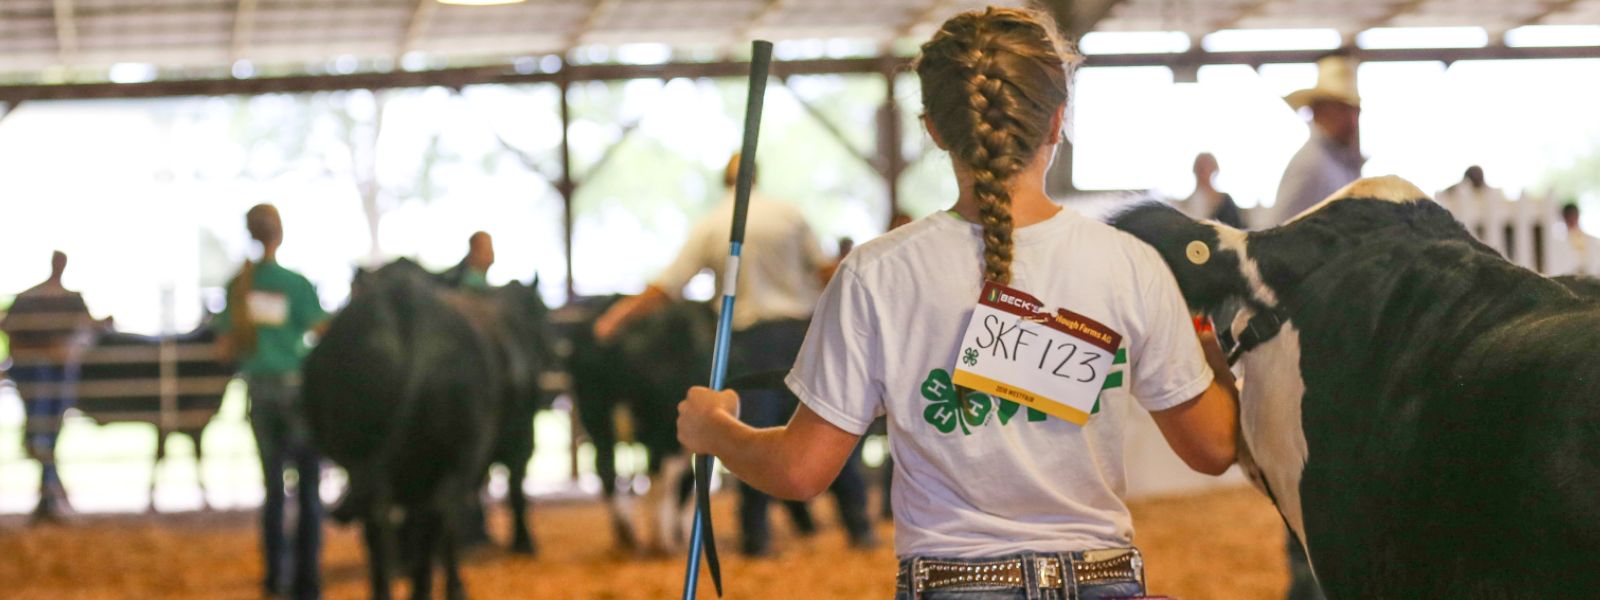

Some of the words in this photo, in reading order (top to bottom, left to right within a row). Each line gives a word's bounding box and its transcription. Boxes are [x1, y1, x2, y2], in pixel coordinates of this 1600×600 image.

[976, 314, 1039, 362] SKF
[1038, 339, 1102, 383] 123
[1055, 314, 1078, 331] Hough
[1078, 322, 1102, 339] Farms
[1101, 333, 1112, 344] AG
